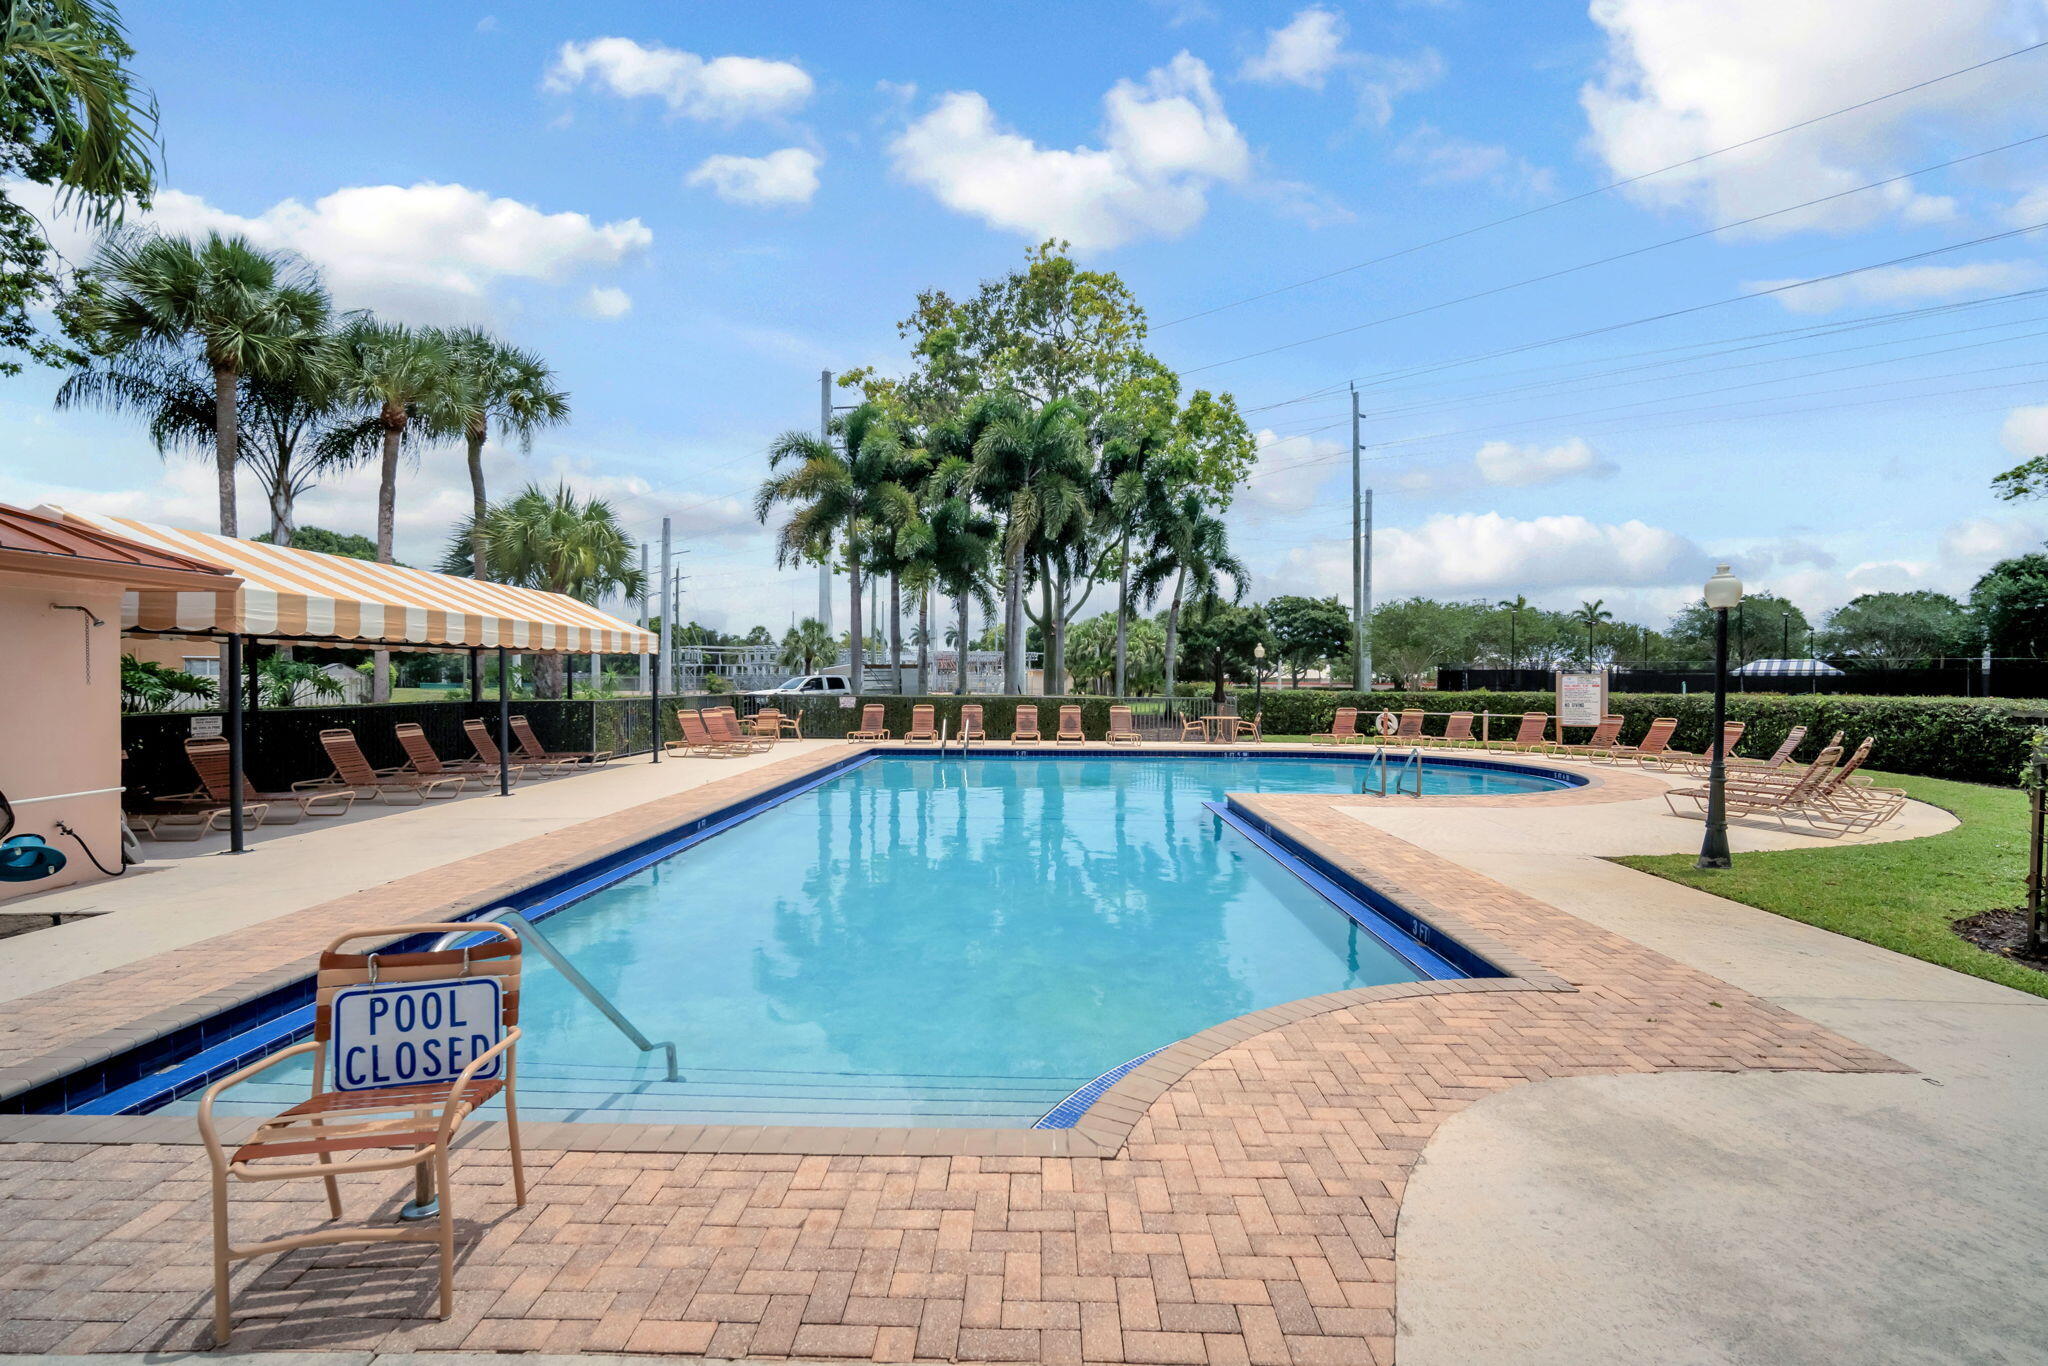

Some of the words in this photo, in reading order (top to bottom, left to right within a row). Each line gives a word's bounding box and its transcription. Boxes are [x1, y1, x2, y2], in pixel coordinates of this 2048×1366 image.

[1412, 919, 1418, 935] 3
[1419, 922, 1429, 942] FT
[370, 990, 467, 1035] POOL
[345, 1034, 490, 1085] CLOSED
